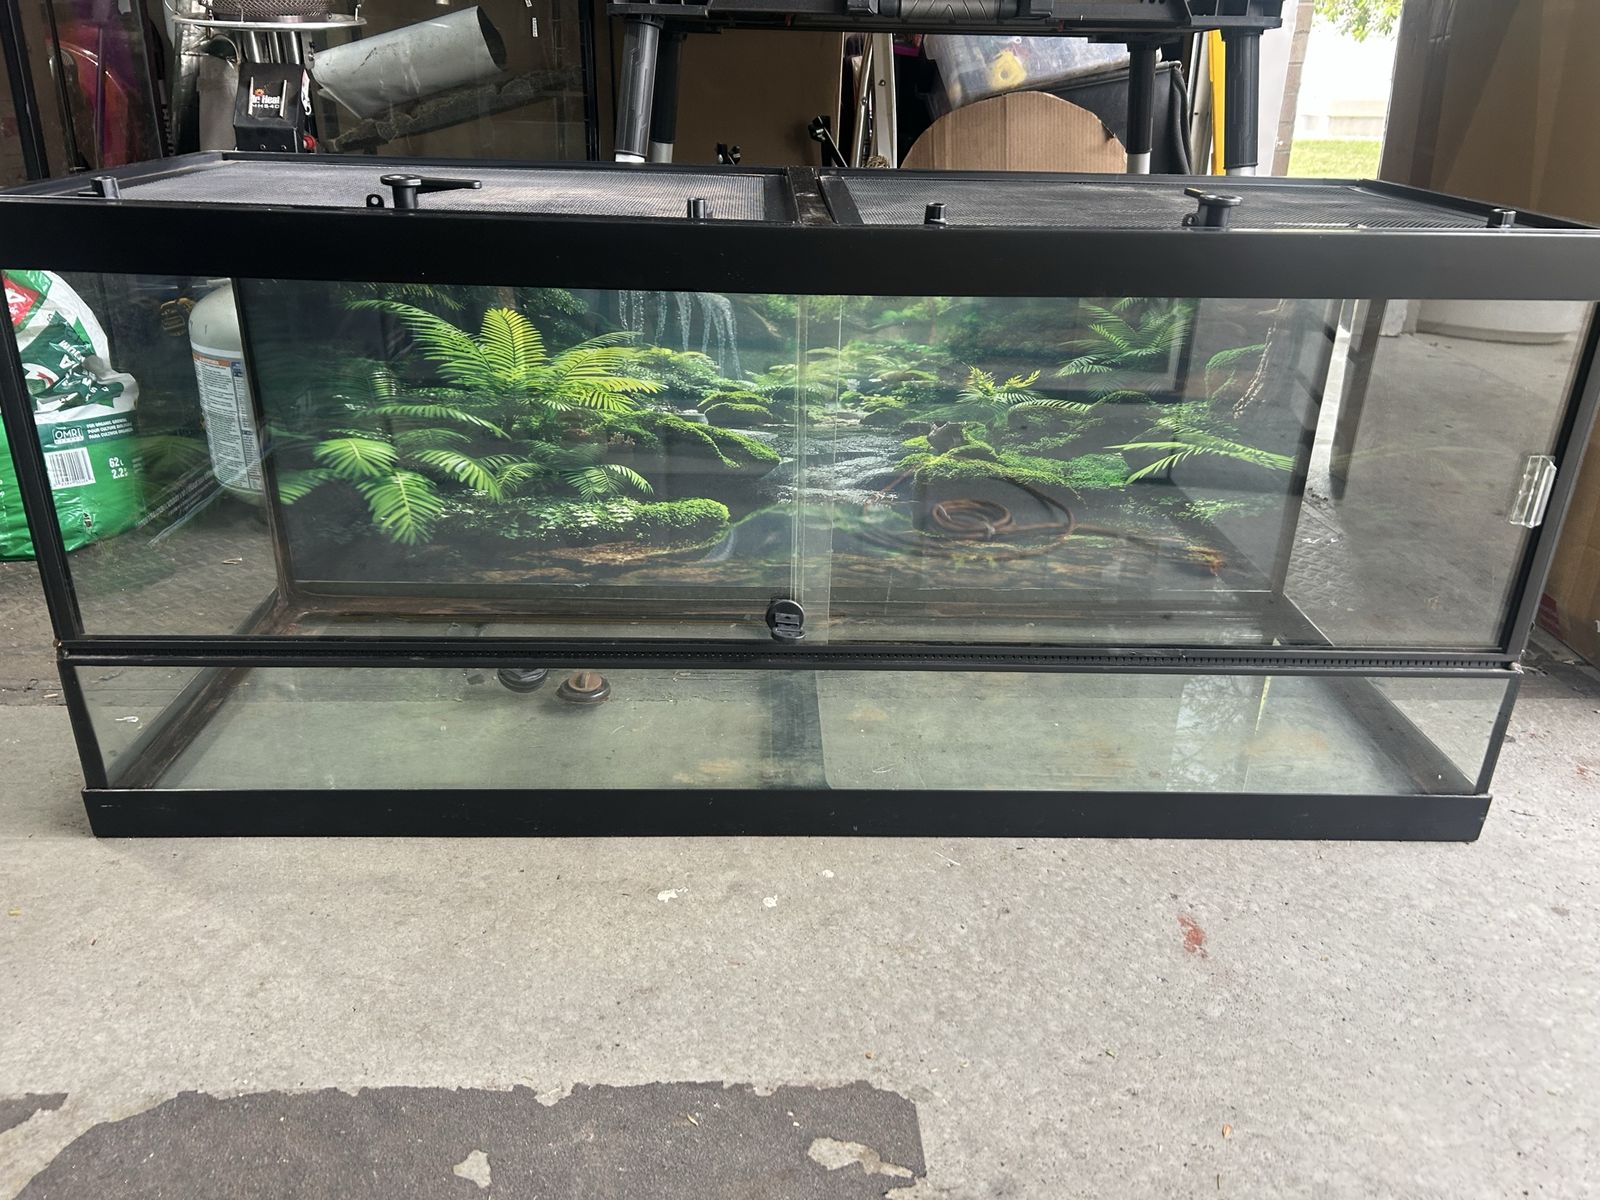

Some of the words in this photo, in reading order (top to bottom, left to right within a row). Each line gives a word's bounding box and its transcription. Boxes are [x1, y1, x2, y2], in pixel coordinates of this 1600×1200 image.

[55, 428, 81, 440] OMRI
[108, 457, 119, 468] 62
[111, 468, 124, 480] 2.2
